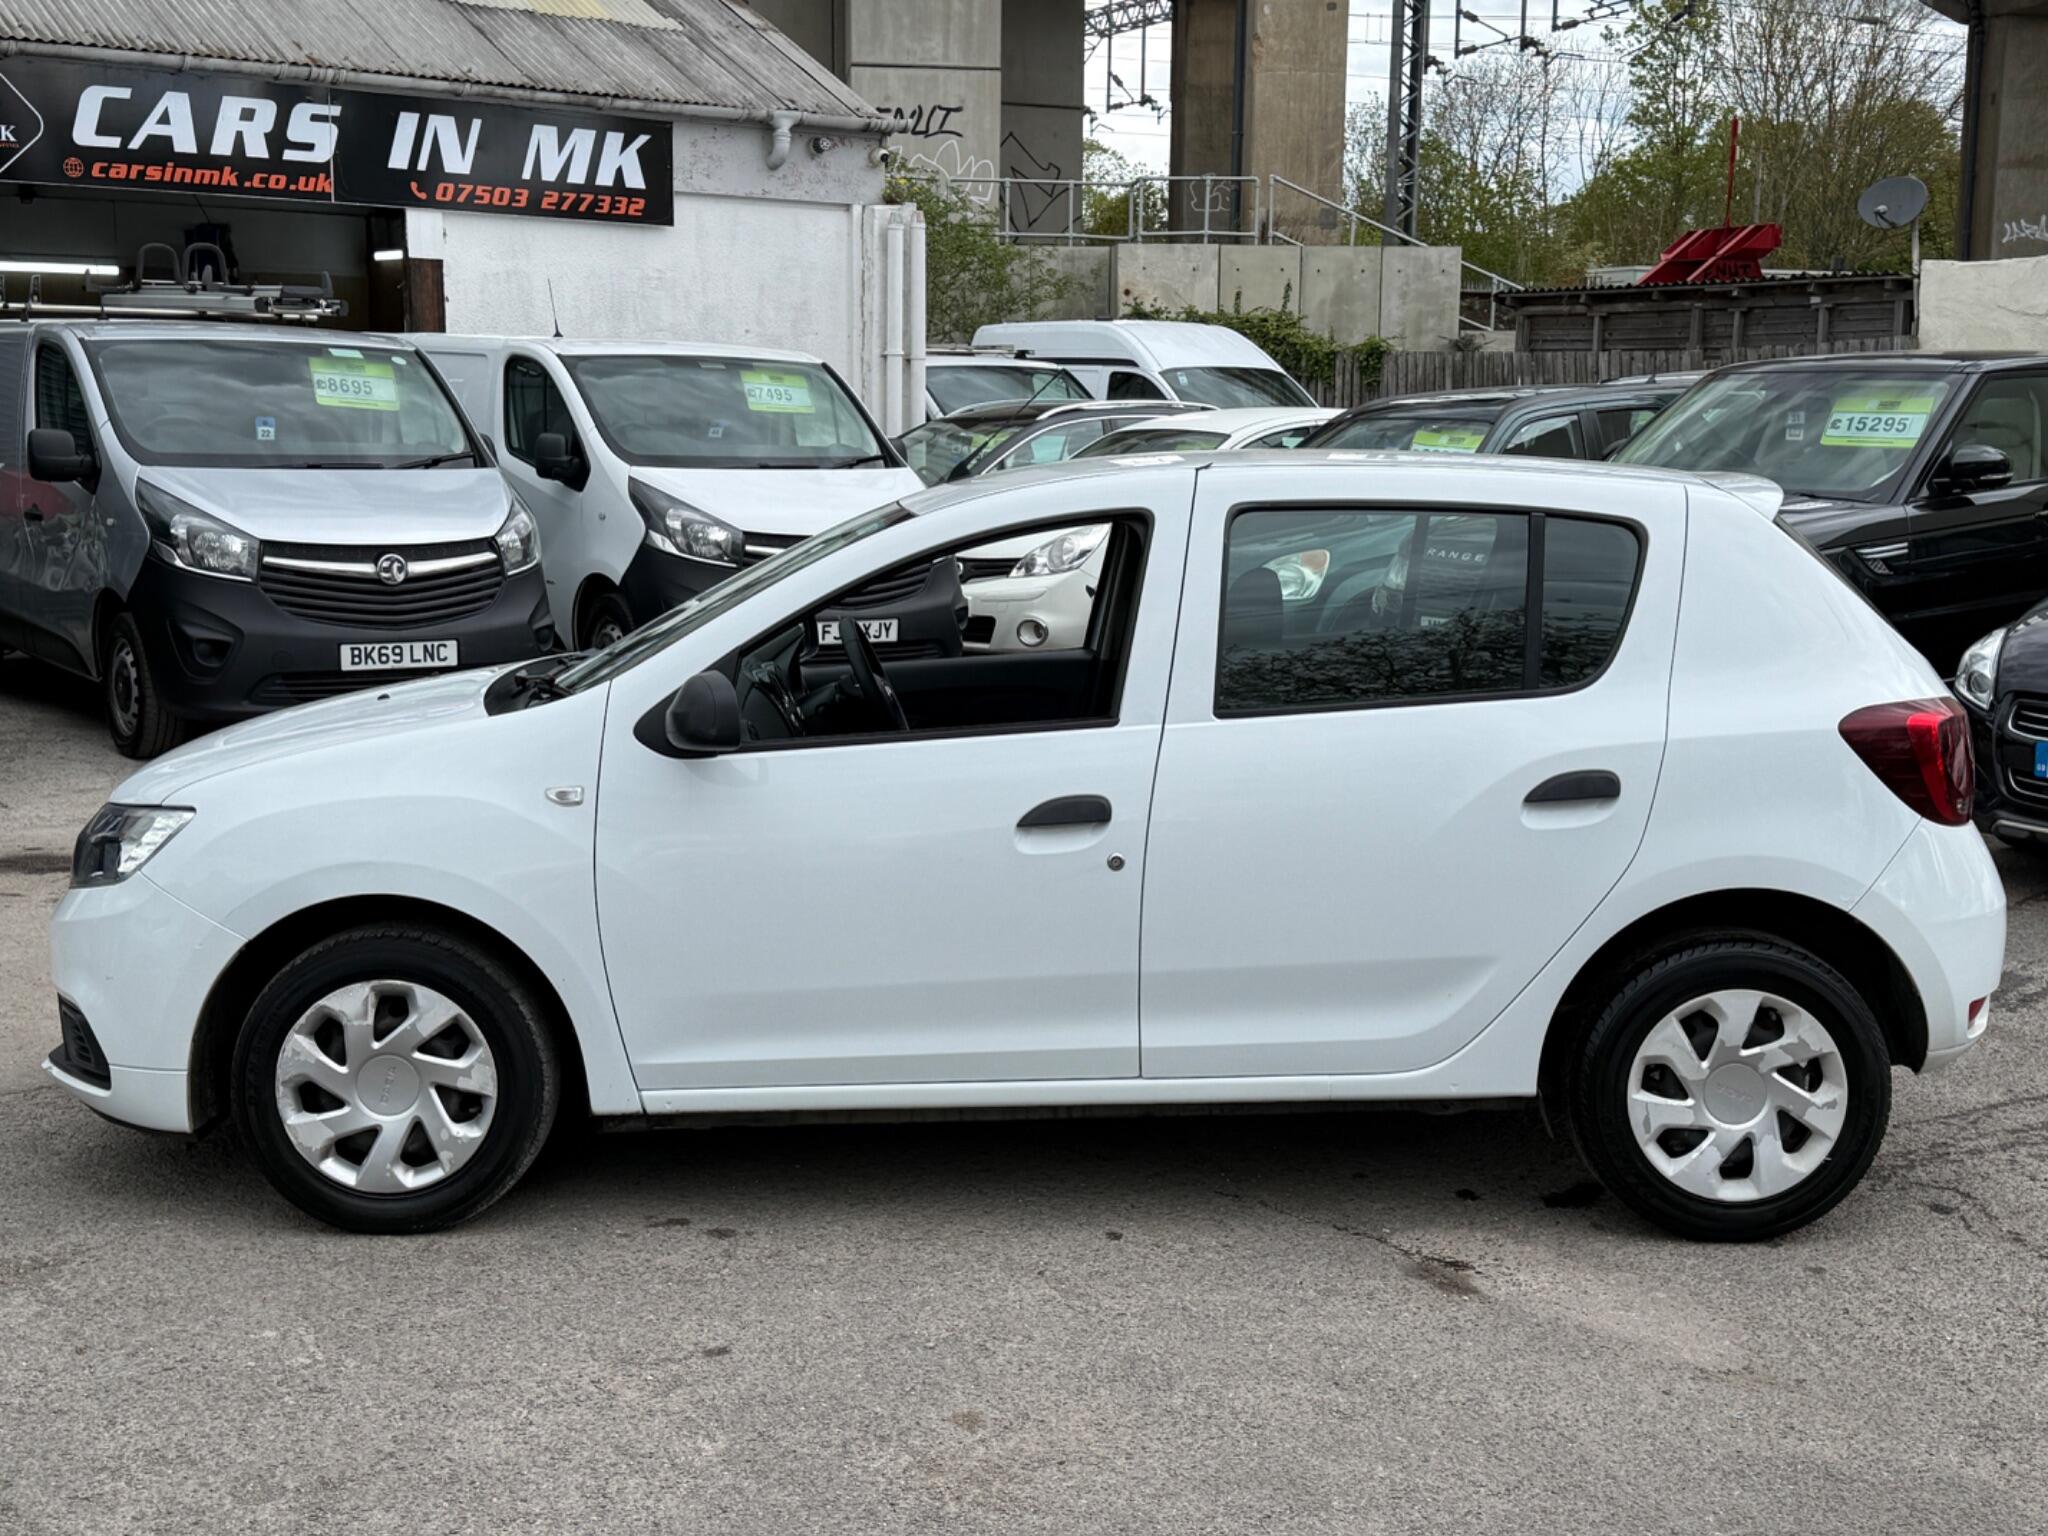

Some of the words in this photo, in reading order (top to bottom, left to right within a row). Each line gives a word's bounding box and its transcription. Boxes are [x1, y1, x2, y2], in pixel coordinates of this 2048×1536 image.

[72, 85, 342, 163] CARS
[387, 111, 482, 175] IN
[521, 124, 652, 190] MK
[435, 182, 529, 208] 07503
[540, 191, 646, 216] 277332
[1830, 416, 1909, 432] £15295
[862, 621, 892, 639] XJY
[350, 645, 403, 666] BK69
[409, 643, 448, 663] LNC
